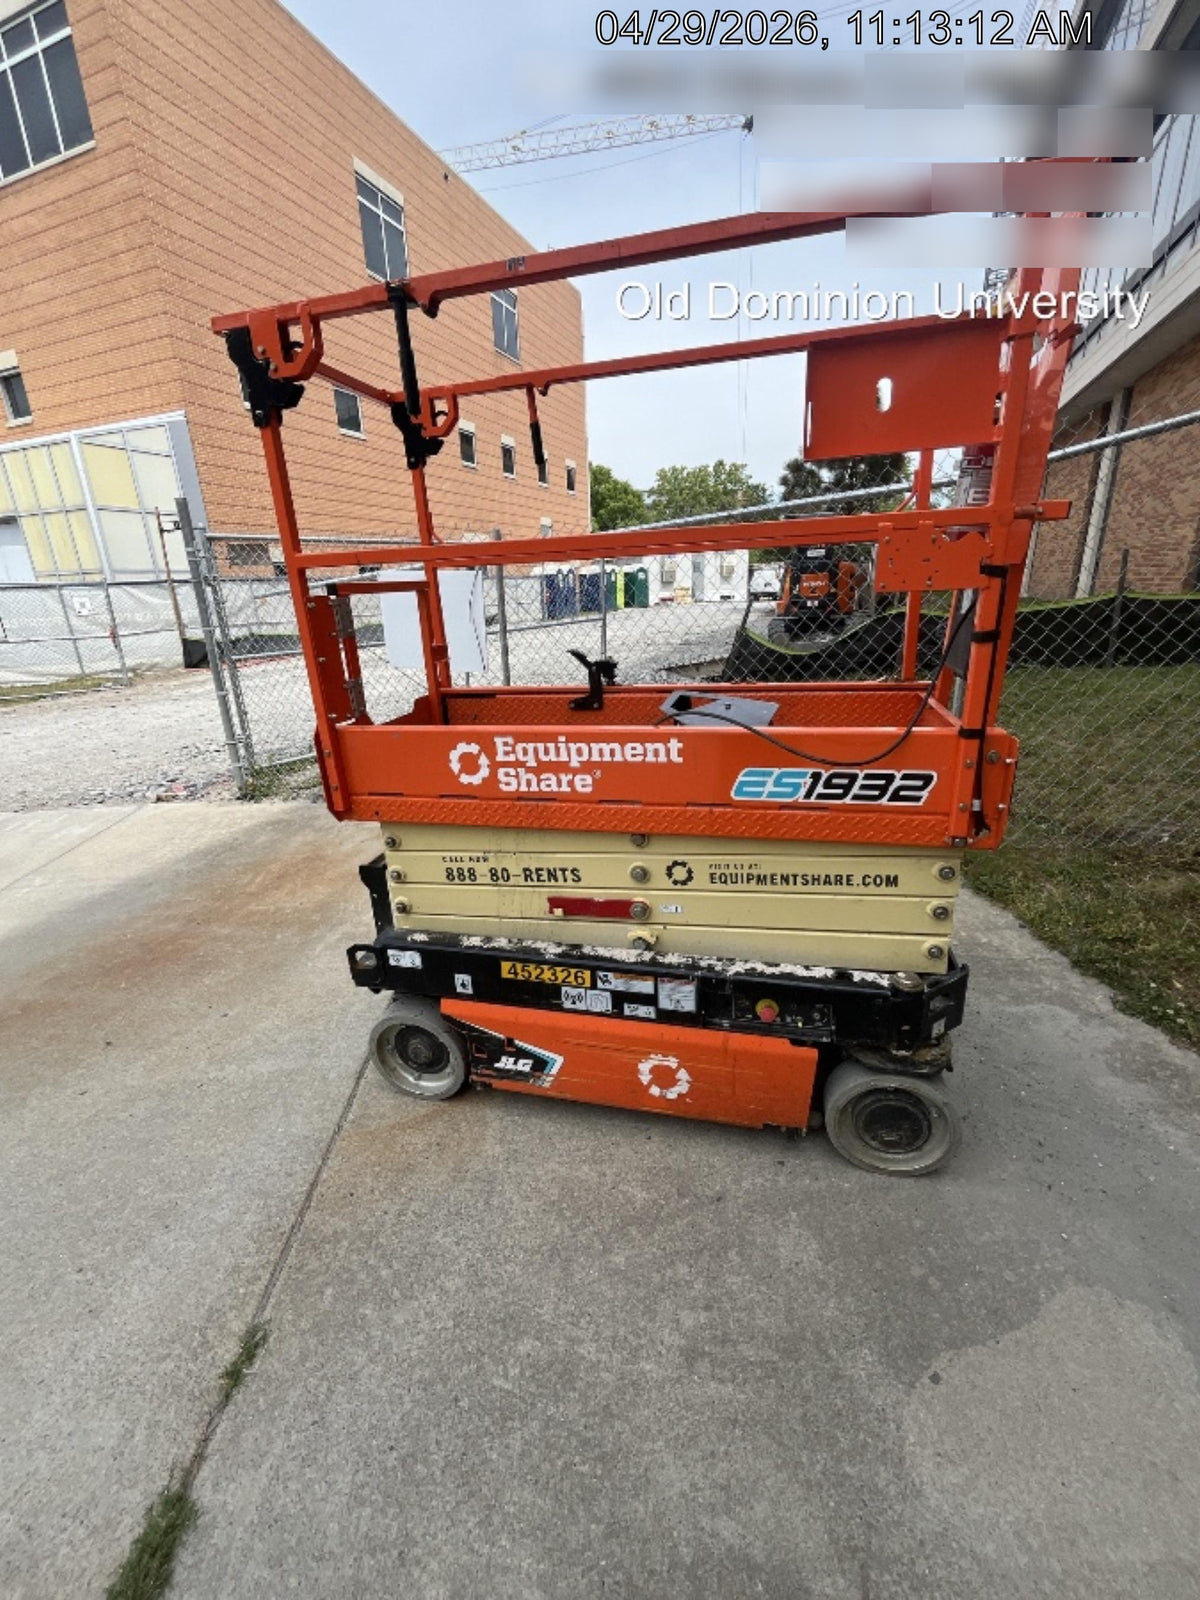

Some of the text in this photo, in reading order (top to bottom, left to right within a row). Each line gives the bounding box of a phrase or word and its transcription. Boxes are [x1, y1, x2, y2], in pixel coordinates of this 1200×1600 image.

[494, 736, 683, 767] Equipment
[731, 767, 938, 806] ES1932
[445, 866, 582, 884] 888-80-RENTS
[709, 872, 899, 887] EQUIPMENTSHARE.COM
[507, 963, 586, 986] 452326
[494, 1055, 534, 1072] JLG
